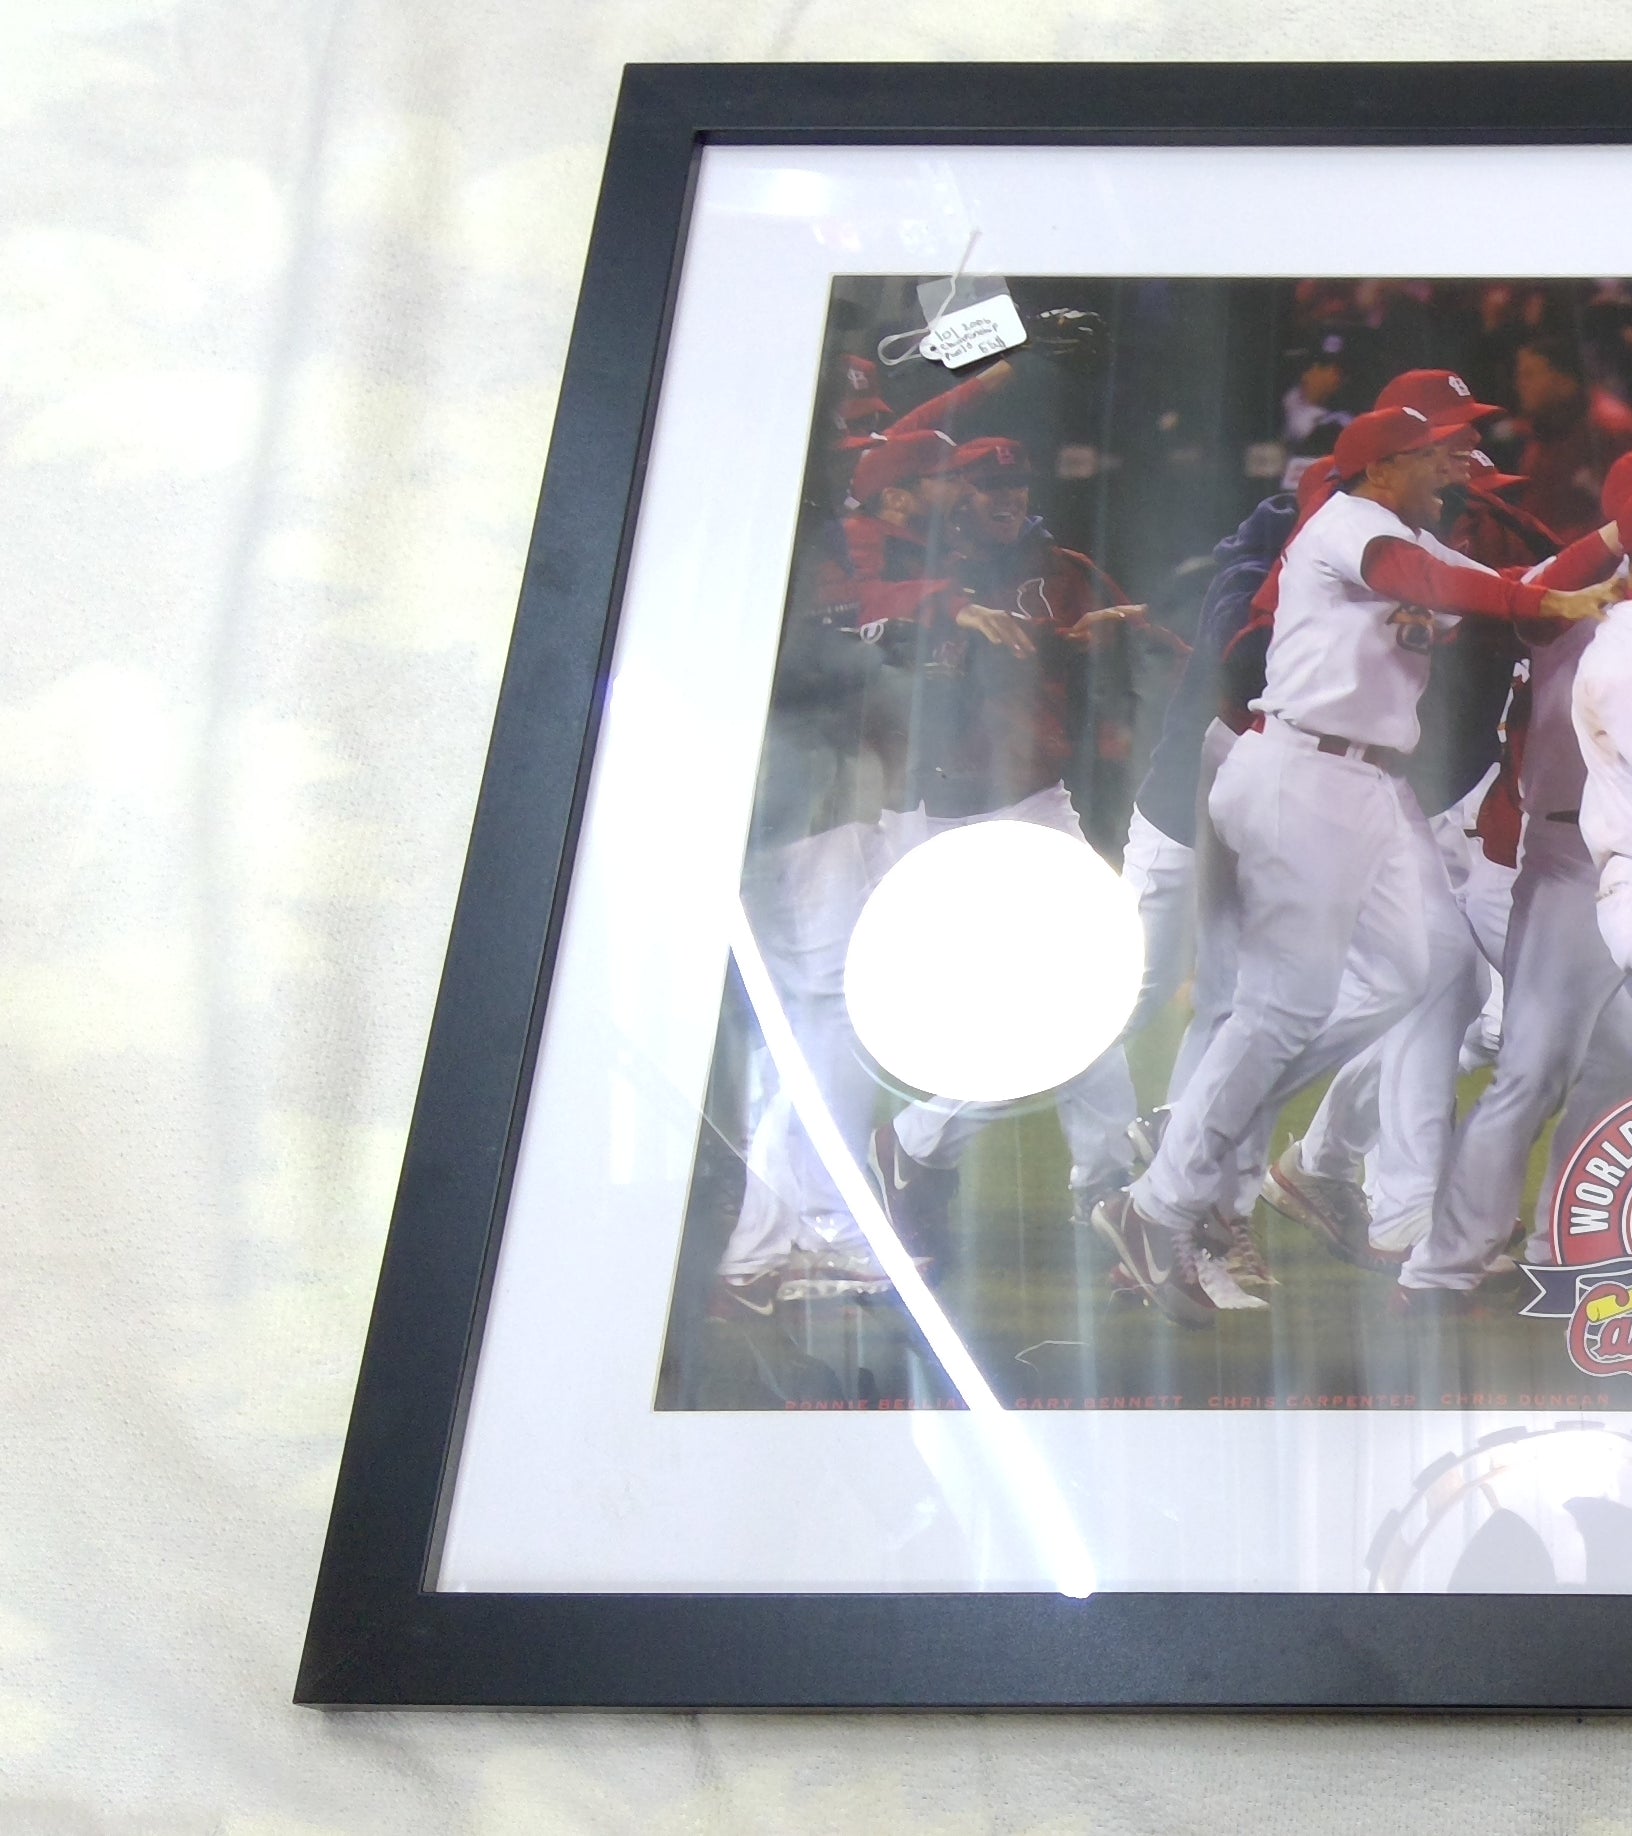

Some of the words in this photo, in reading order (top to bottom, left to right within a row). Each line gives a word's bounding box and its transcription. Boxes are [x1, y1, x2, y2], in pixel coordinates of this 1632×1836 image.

[1015, 1397, 1073, 1409] GARY
[1083, 1395, 1183, 1409] BENNETT
[1207, 1396, 1276, 1409] CHRIS
[1286, 1394, 1416, 1408] CARPENTER
[1441, 1393, 1508, 1406] CHRIS
[1519, 1393, 1610, 1407] DUNCAN
